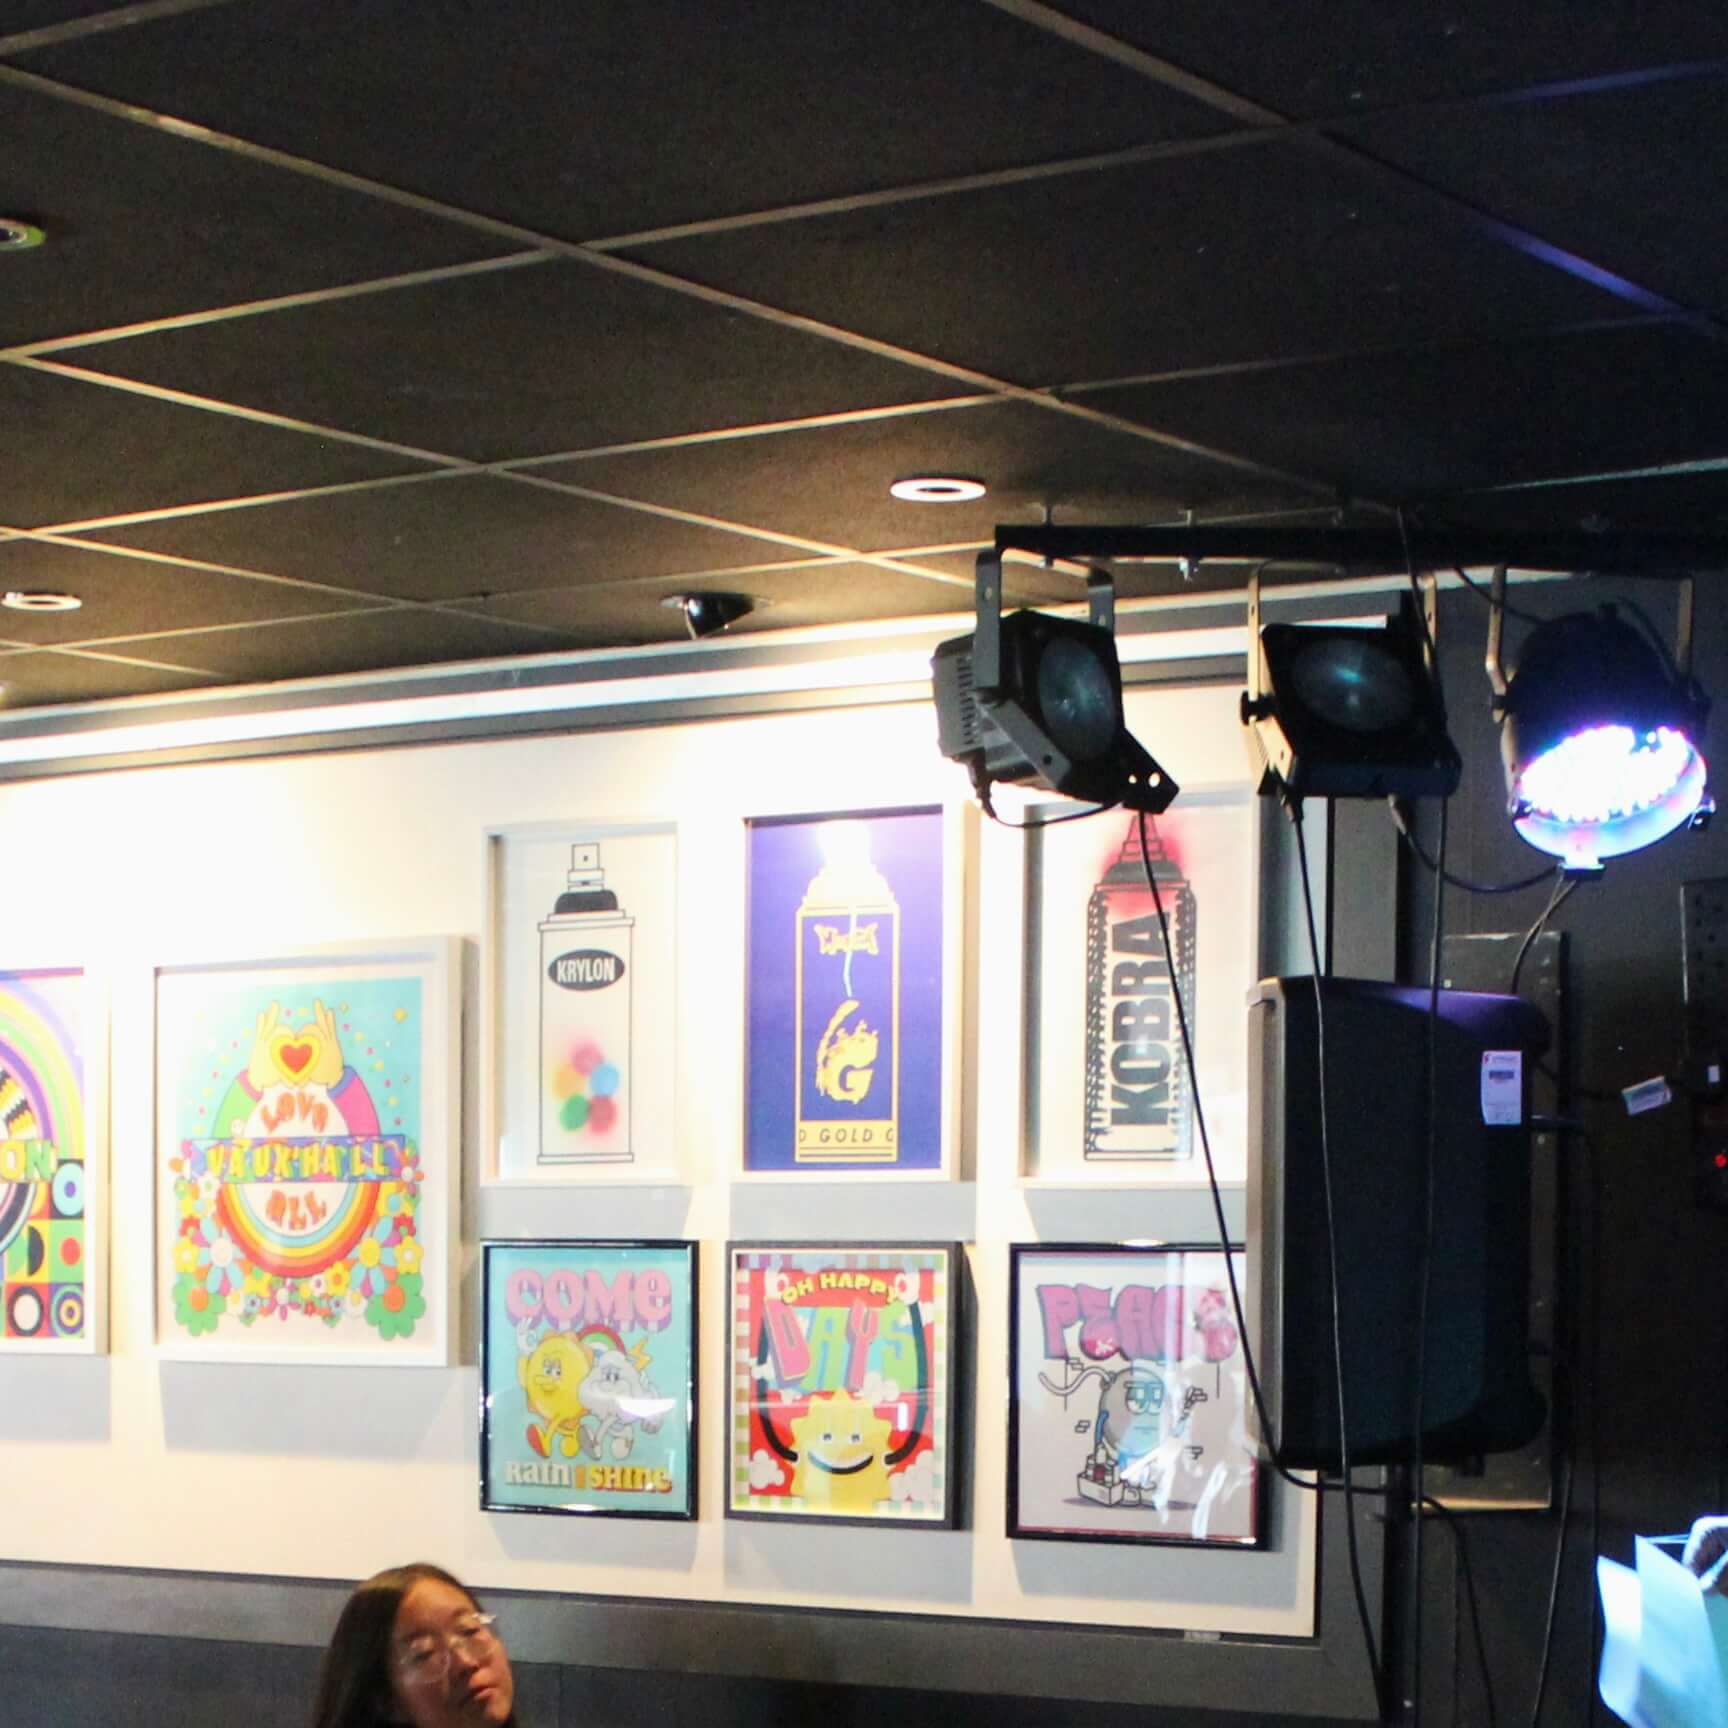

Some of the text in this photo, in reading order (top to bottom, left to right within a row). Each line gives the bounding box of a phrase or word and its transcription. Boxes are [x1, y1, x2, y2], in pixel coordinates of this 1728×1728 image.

[556, 957, 615, 983] KRYLON
[1110, 911, 1171, 1126] KOBRA
[819, 1128, 873, 1143] GOLD
[207, 1140, 390, 1178] VAUXHALL
[782, 1272, 898, 1304] OH HAPPY
[765, 1298, 920, 1388] DAYS
